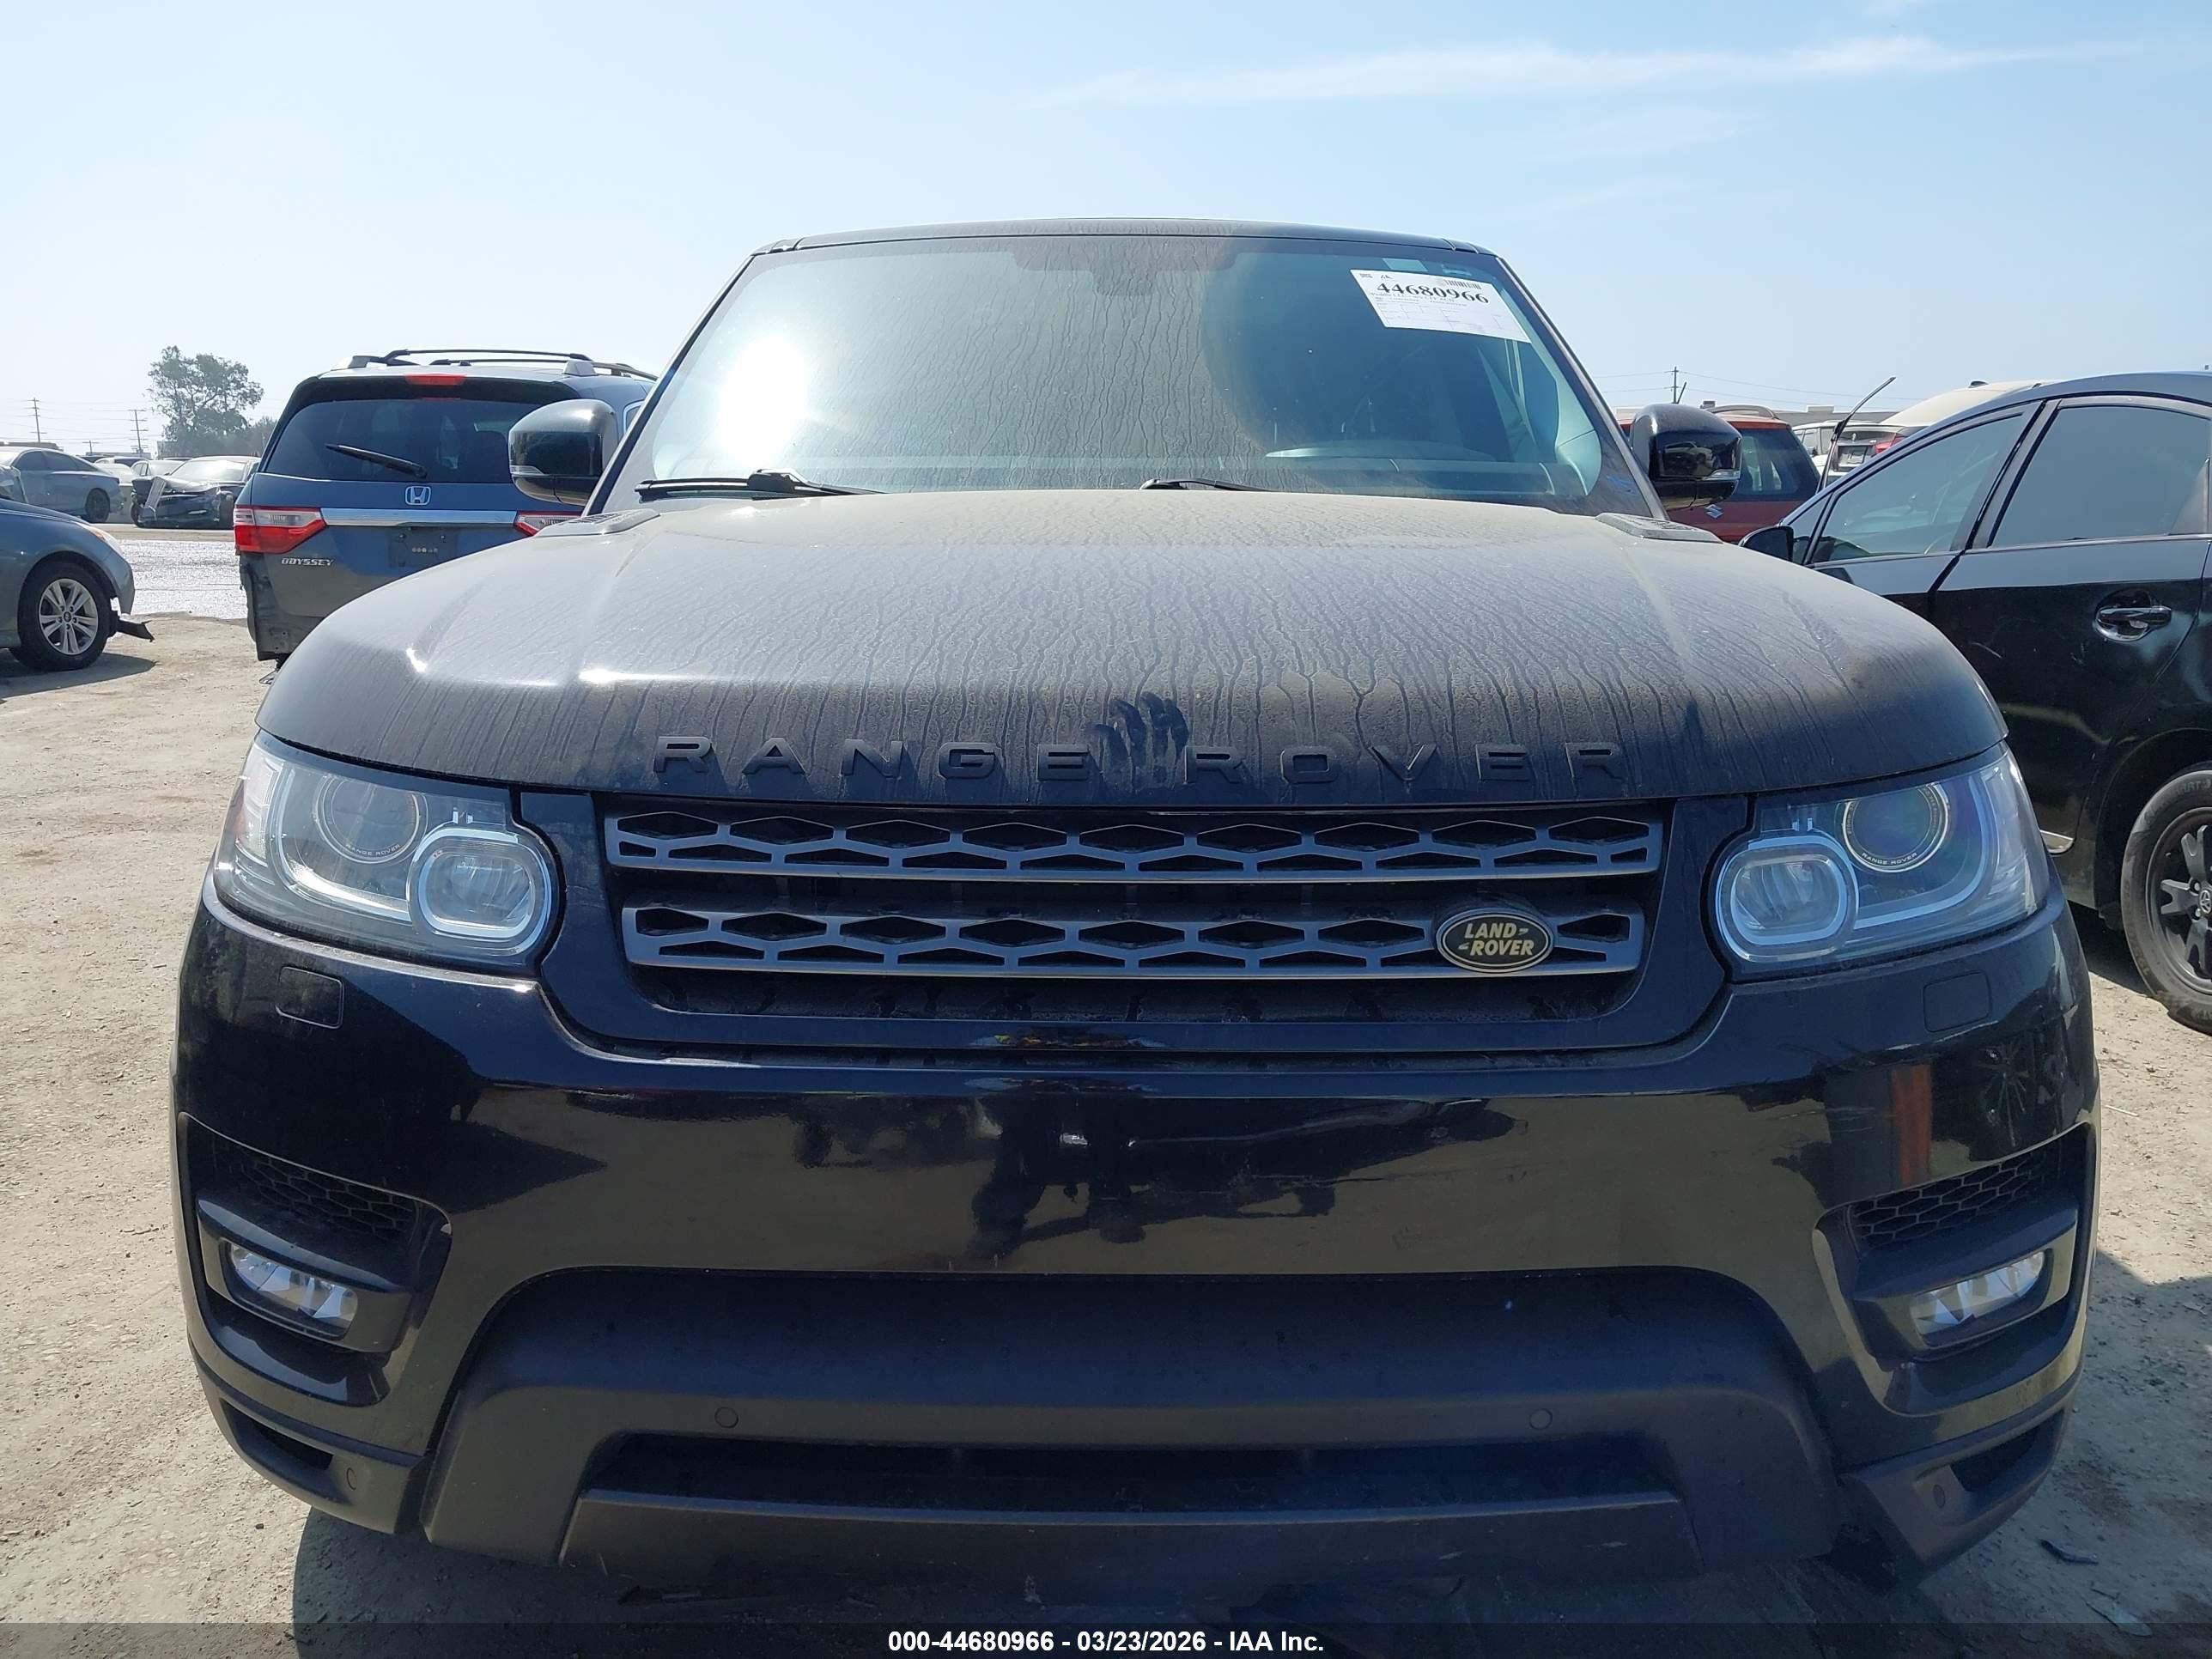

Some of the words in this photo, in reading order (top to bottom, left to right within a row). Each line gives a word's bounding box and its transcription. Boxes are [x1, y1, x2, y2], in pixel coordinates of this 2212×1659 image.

[1376, 282, 1489, 304] 44680966
[281, 557, 334, 566] ODYSSEY
[653, 736, 1091, 782] RANGE
[1183, 742, 1627, 785] ROVER
[1861, 852, 1888, 866] RANGE
[1890, 852, 1917, 866] ROVER
[1464, 922, 1517, 939] LAND
[1469, 939, 1534, 956] ROVER
